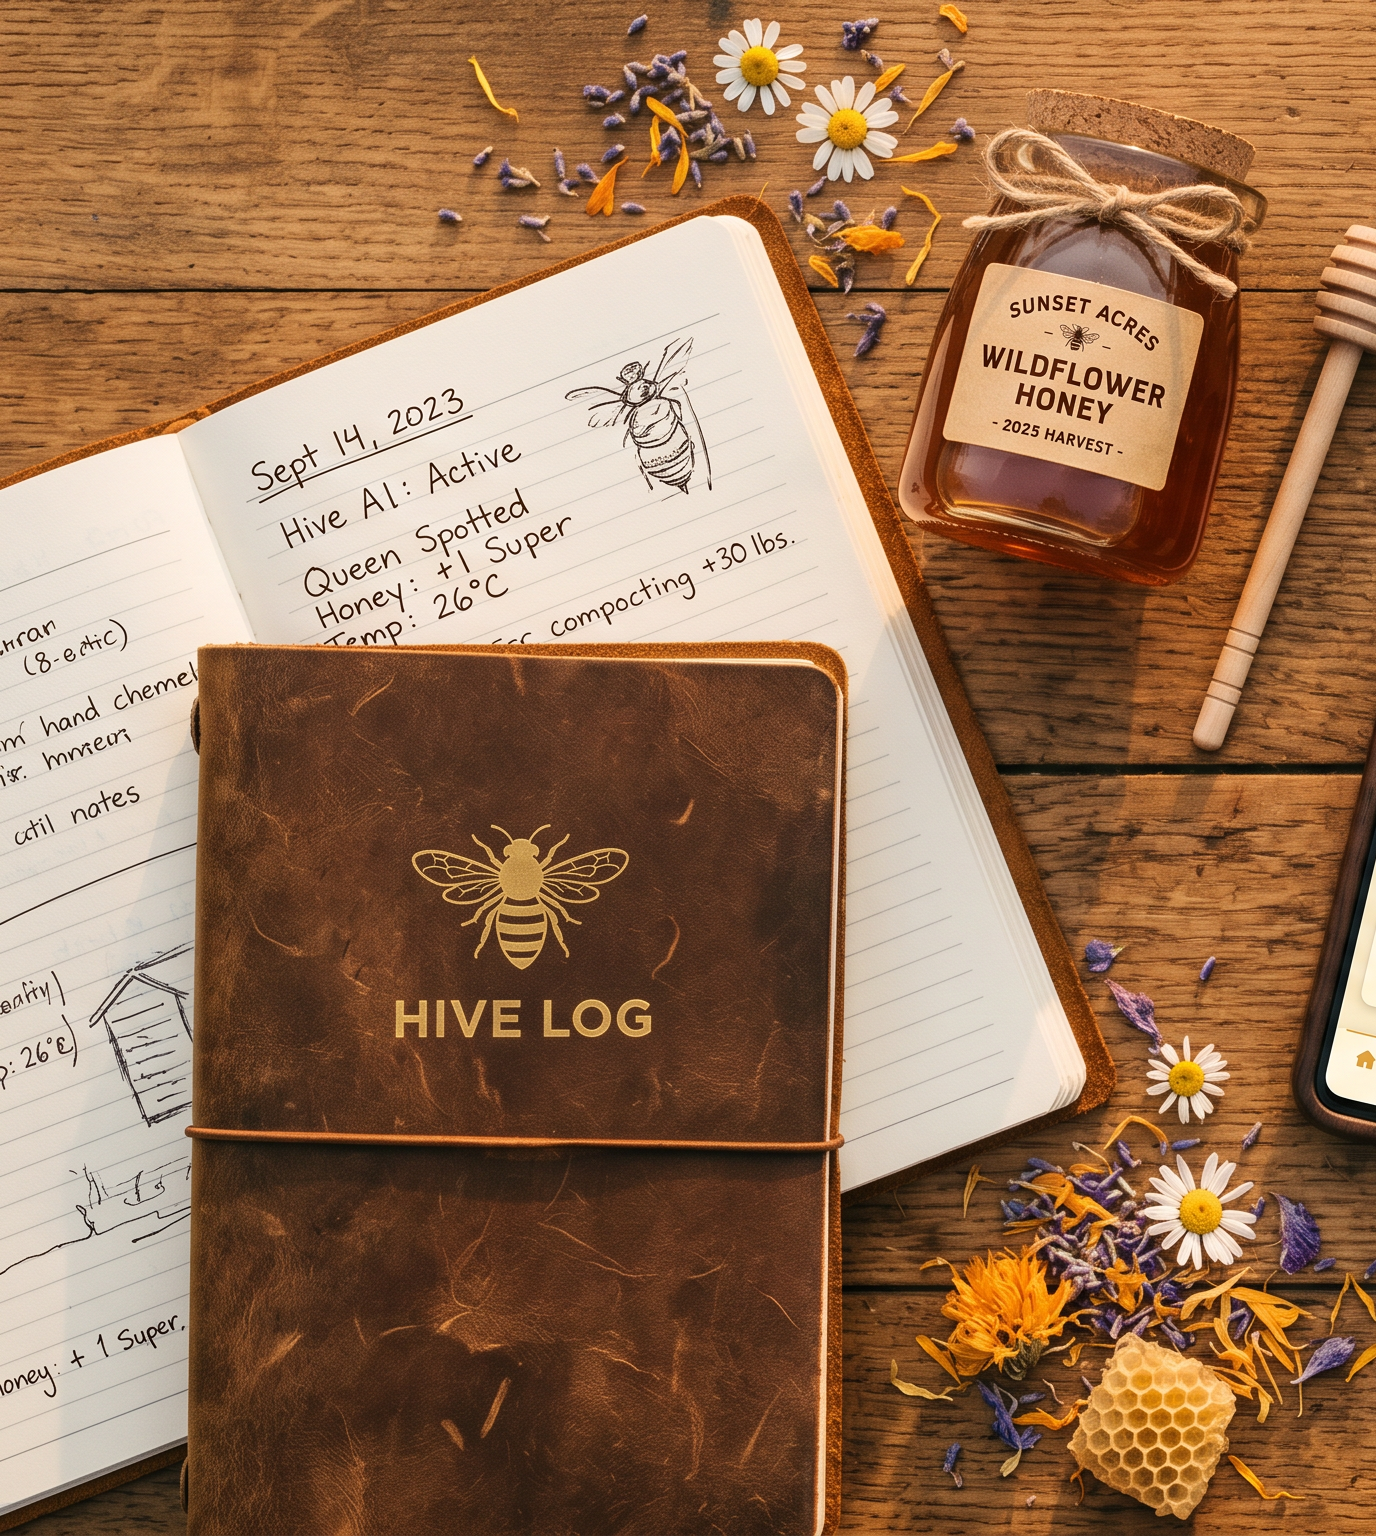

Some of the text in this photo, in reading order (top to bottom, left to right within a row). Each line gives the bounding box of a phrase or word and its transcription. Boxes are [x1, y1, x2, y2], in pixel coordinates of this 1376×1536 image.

[1009, 293, 1160, 351] SUNSET ACRES
[982, 343, 1166, 408] WILDFLOWER
[1014, 382, 1114, 424] HONEY
[251, 388, 464, 491] Sept 14, 2023
[1002, 418, 1040, 438] 2025
[1044, 427, 1114, 455] HARVEST
[280, 510, 348, 549] Hive
[429, 440, 521, 494] Active
[303, 487, 530, 599] Queen Spotted
[702, 542, 748, 573] +30
[750, 531, 796, 556] lbs.
[315, 577, 420, 629] Honey:
[484, 516, 572, 564] Super
[433, 573, 510, 620] 26°C
[39, 695, 101, 737] hand
[395, 998, 652, 1038] HIVE LOG
[96, 1333, 109, 1358] 1
